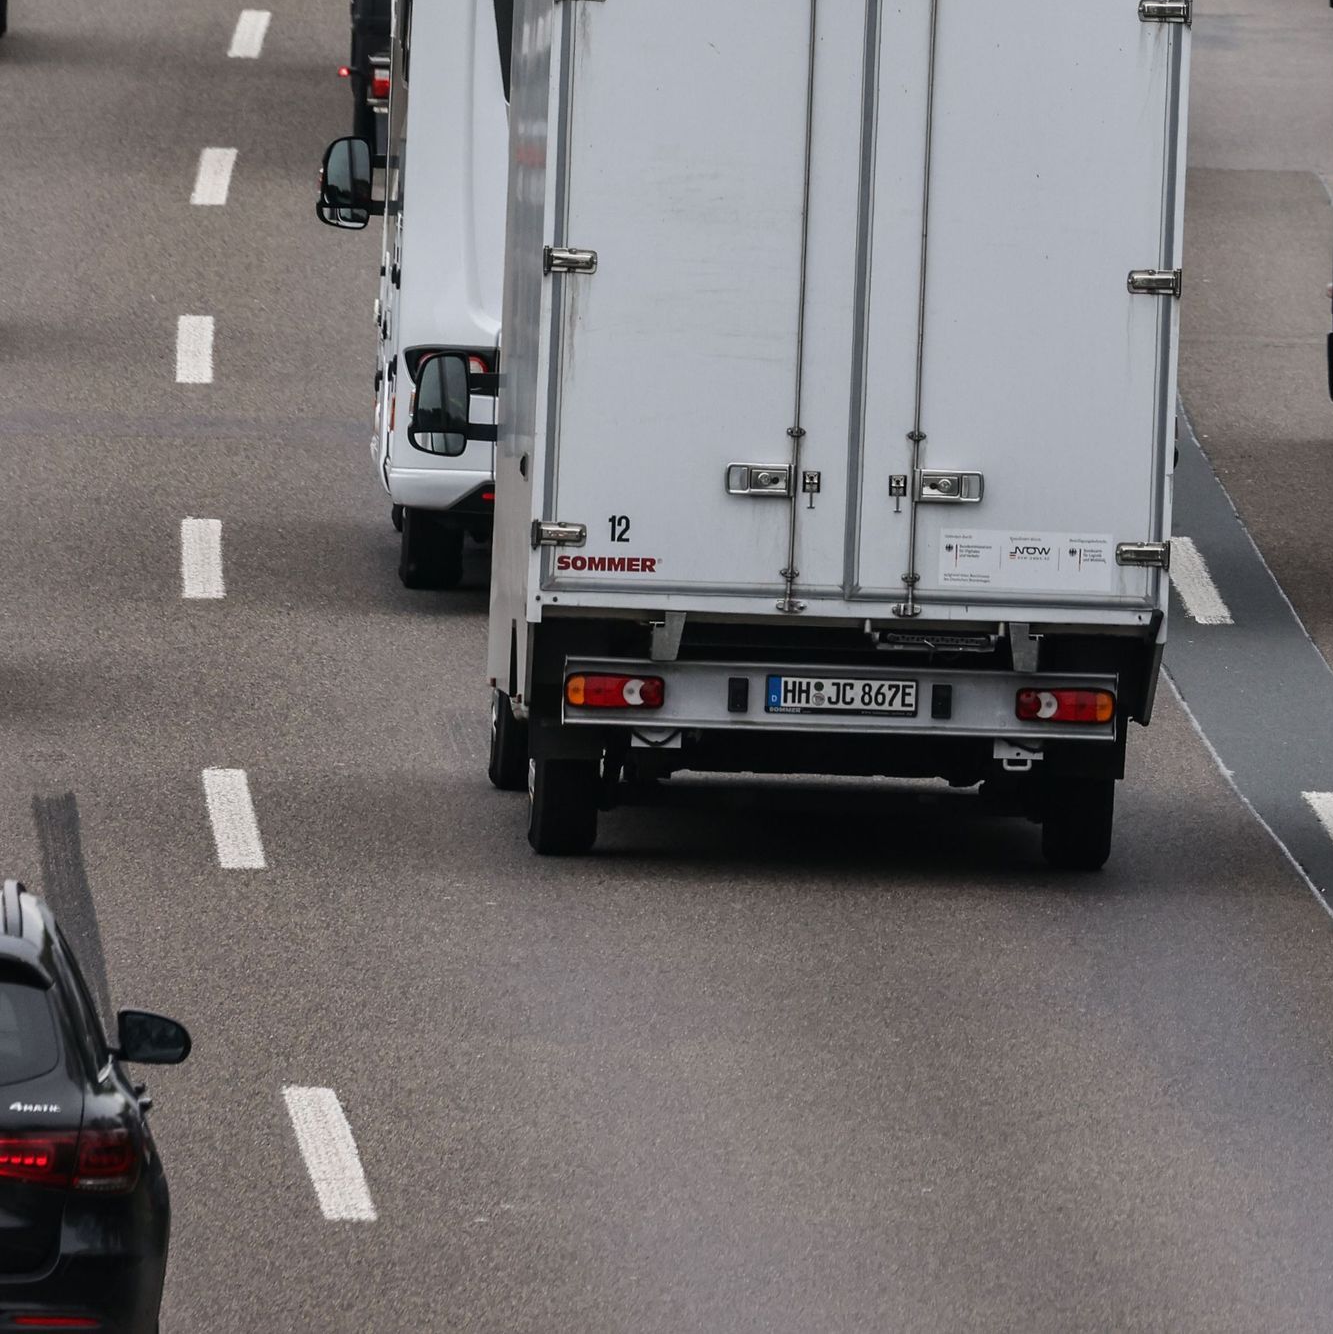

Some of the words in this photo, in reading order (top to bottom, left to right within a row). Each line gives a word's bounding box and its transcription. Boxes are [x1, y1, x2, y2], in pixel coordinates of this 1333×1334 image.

[608, 515, 631, 542] 12
[557, 555, 657, 573] SOMMER
[783, 681, 811, 704] HH
[828, 682, 854, 705] JC
[861, 683, 914, 708] 867E
